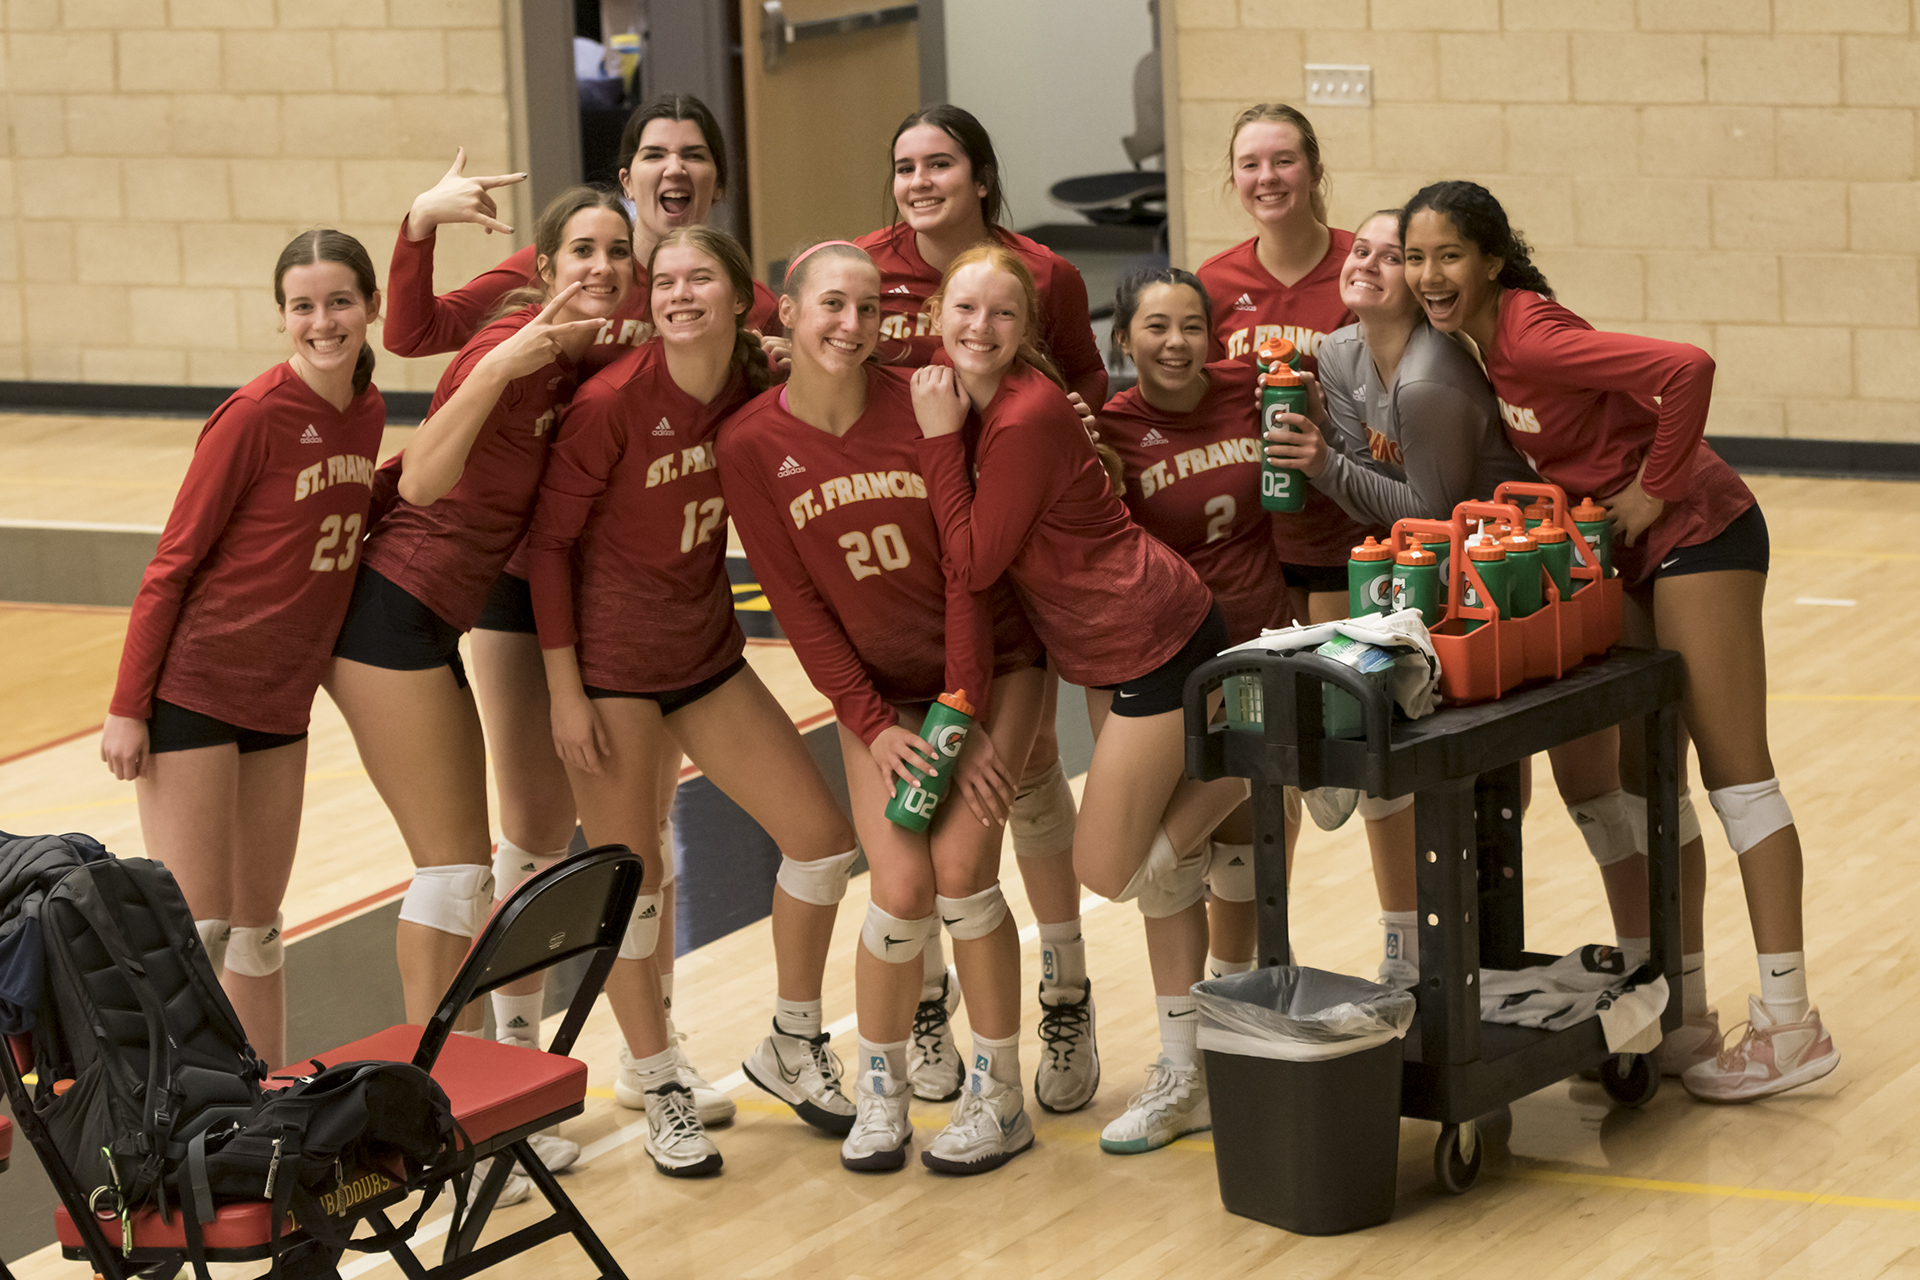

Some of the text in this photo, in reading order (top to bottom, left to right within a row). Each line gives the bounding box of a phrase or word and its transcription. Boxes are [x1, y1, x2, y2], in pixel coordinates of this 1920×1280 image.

[1227, 327, 1250, 361] ST.
[1497, 396, 1542, 434] NCIS
[1140, 438, 1169, 448] adidas
[294, 460, 326, 502] ST.
[645, 452, 678, 489] ST.
[777, 466, 806, 479] adidas
[1139, 459, 1175, 500] ST.
[788, 470, 928, 530] ST. FRANCIS
[1203, 494, 1236, 545] 2
[309, 513, 362, 573] 23
[680, 496, 725, 554] 12
[837, 523, 911, 582] 20
[937, 724, 968, 758] G
